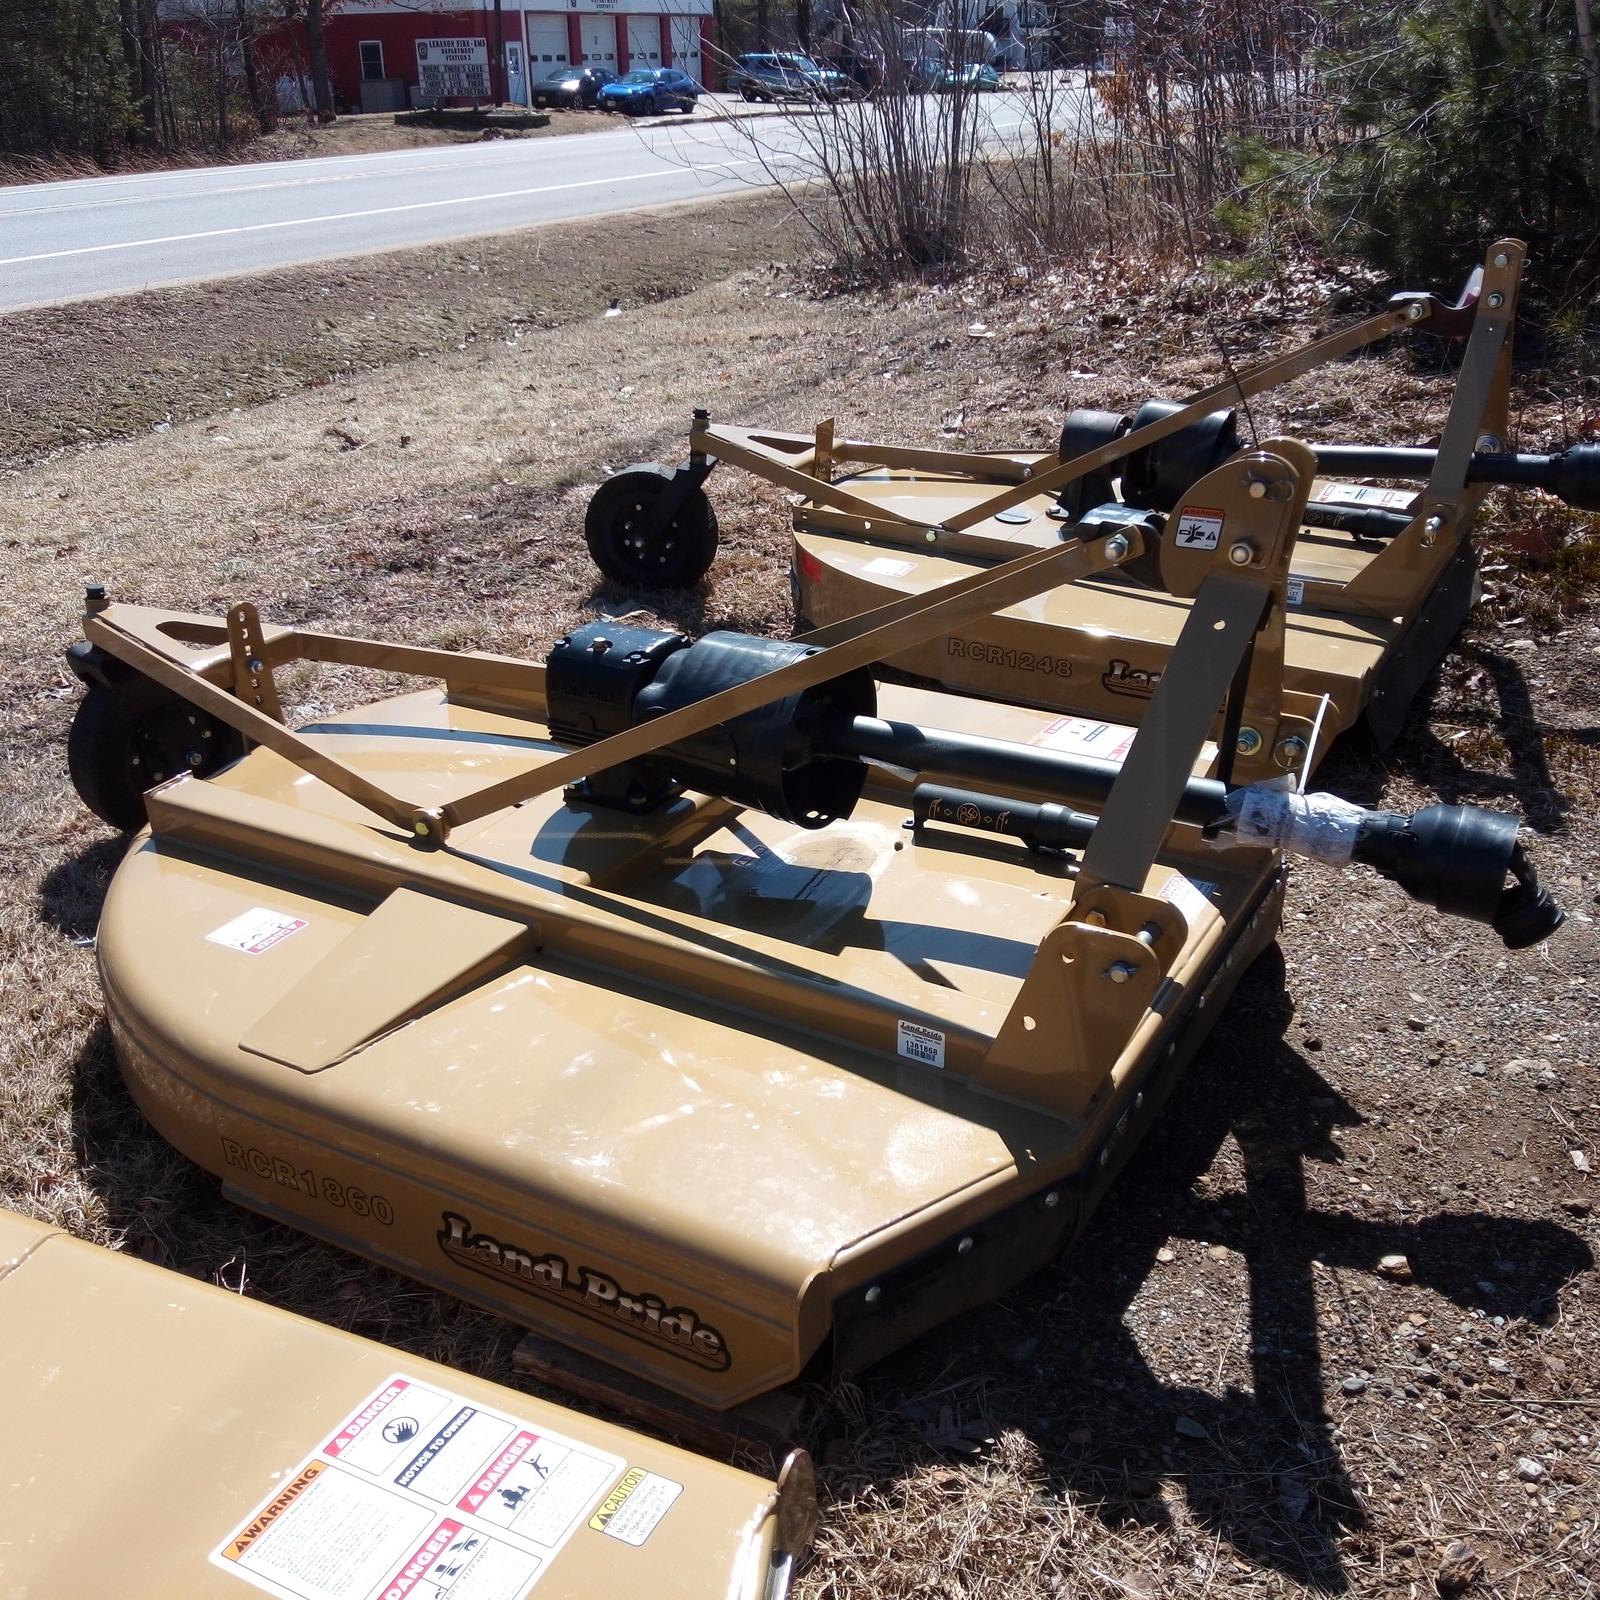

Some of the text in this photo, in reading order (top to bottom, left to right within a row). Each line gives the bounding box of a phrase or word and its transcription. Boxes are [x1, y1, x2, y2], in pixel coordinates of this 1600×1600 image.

[948, 637, 1073, 678] RCR1248
[1105, 660, 1163, 691] La
[221, 1137, 394, 1226] RCR1860
[444, 1215, 723, 1357] Land Pride
[346, 1386, 400, 1435] DANGER
[398, 1408, 475, 1486] NOTICE TO OWNER
[477, 1436, 532, 1492] DANGER
[242, 1468, 320, 1539] WARNING
[602, 1470, 644, 1512] CAUTION
[383, 1528, 454, 1600] DANGER
